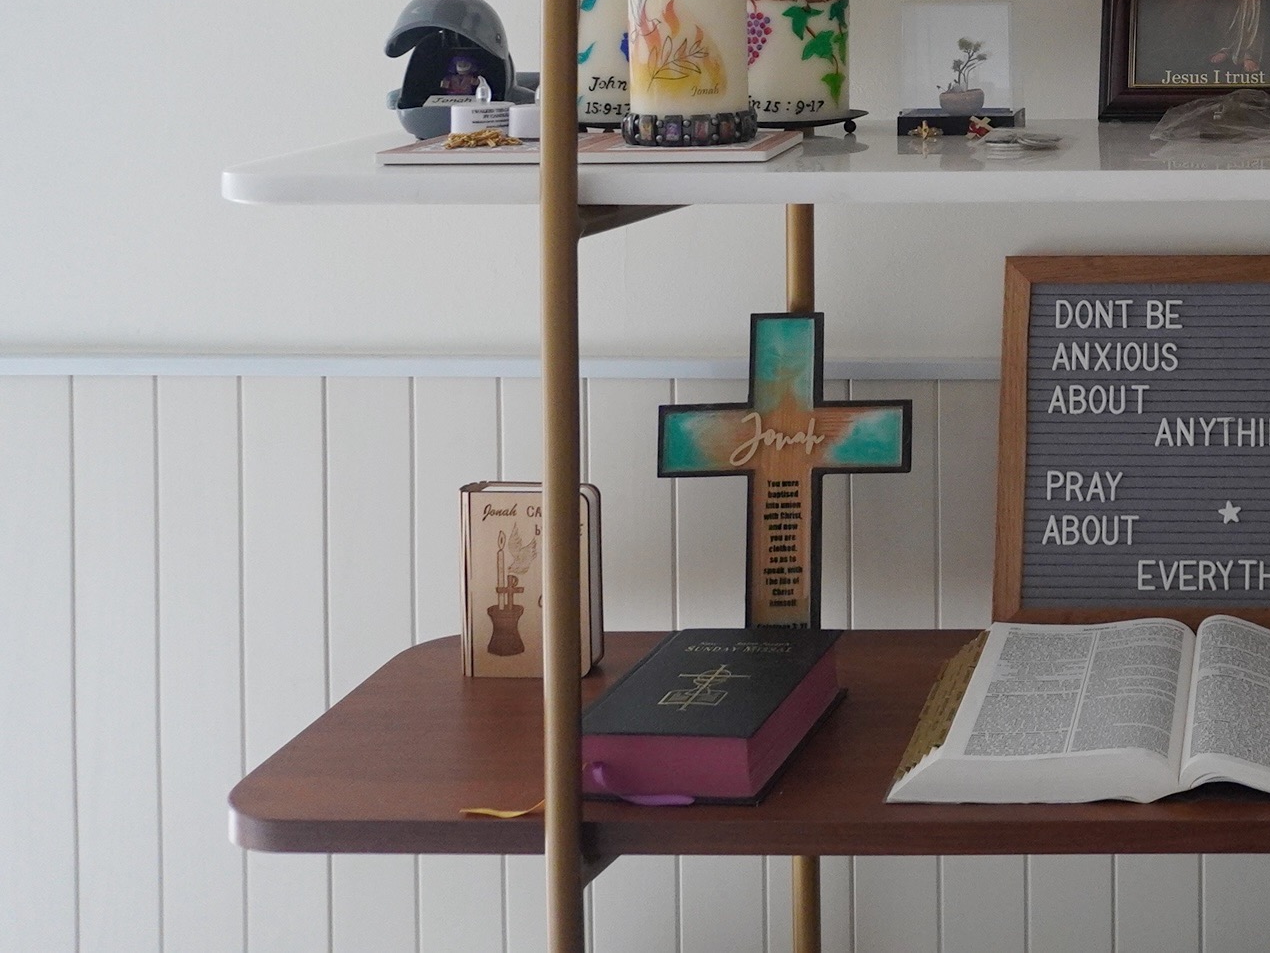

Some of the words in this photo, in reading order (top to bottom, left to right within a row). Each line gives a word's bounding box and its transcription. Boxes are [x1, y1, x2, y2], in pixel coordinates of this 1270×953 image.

[588, 76, 628, 92] John
[690, 85, 719, 96] Jonah
[1161, 69, 1208, 85] Jesus
[1213, 69, 1221, 84] I
[1225, 70, 1265, 84] trust
[1055, 299, 1133, 329] DONT
[1146, 299, 1183, 329] BE
[1052, 342, 1179, 372] ANXIOUS
[1048, 384, 1150, 415] ABOUT
[729, 412, 825, 467] Jonah
[1046, 470, 1123, 502] PRAY
[482, 503, 517, 521] Jonah
[1042, 514, 1139, 546] ABOUT
[772, 588, 794, 596] Christ
